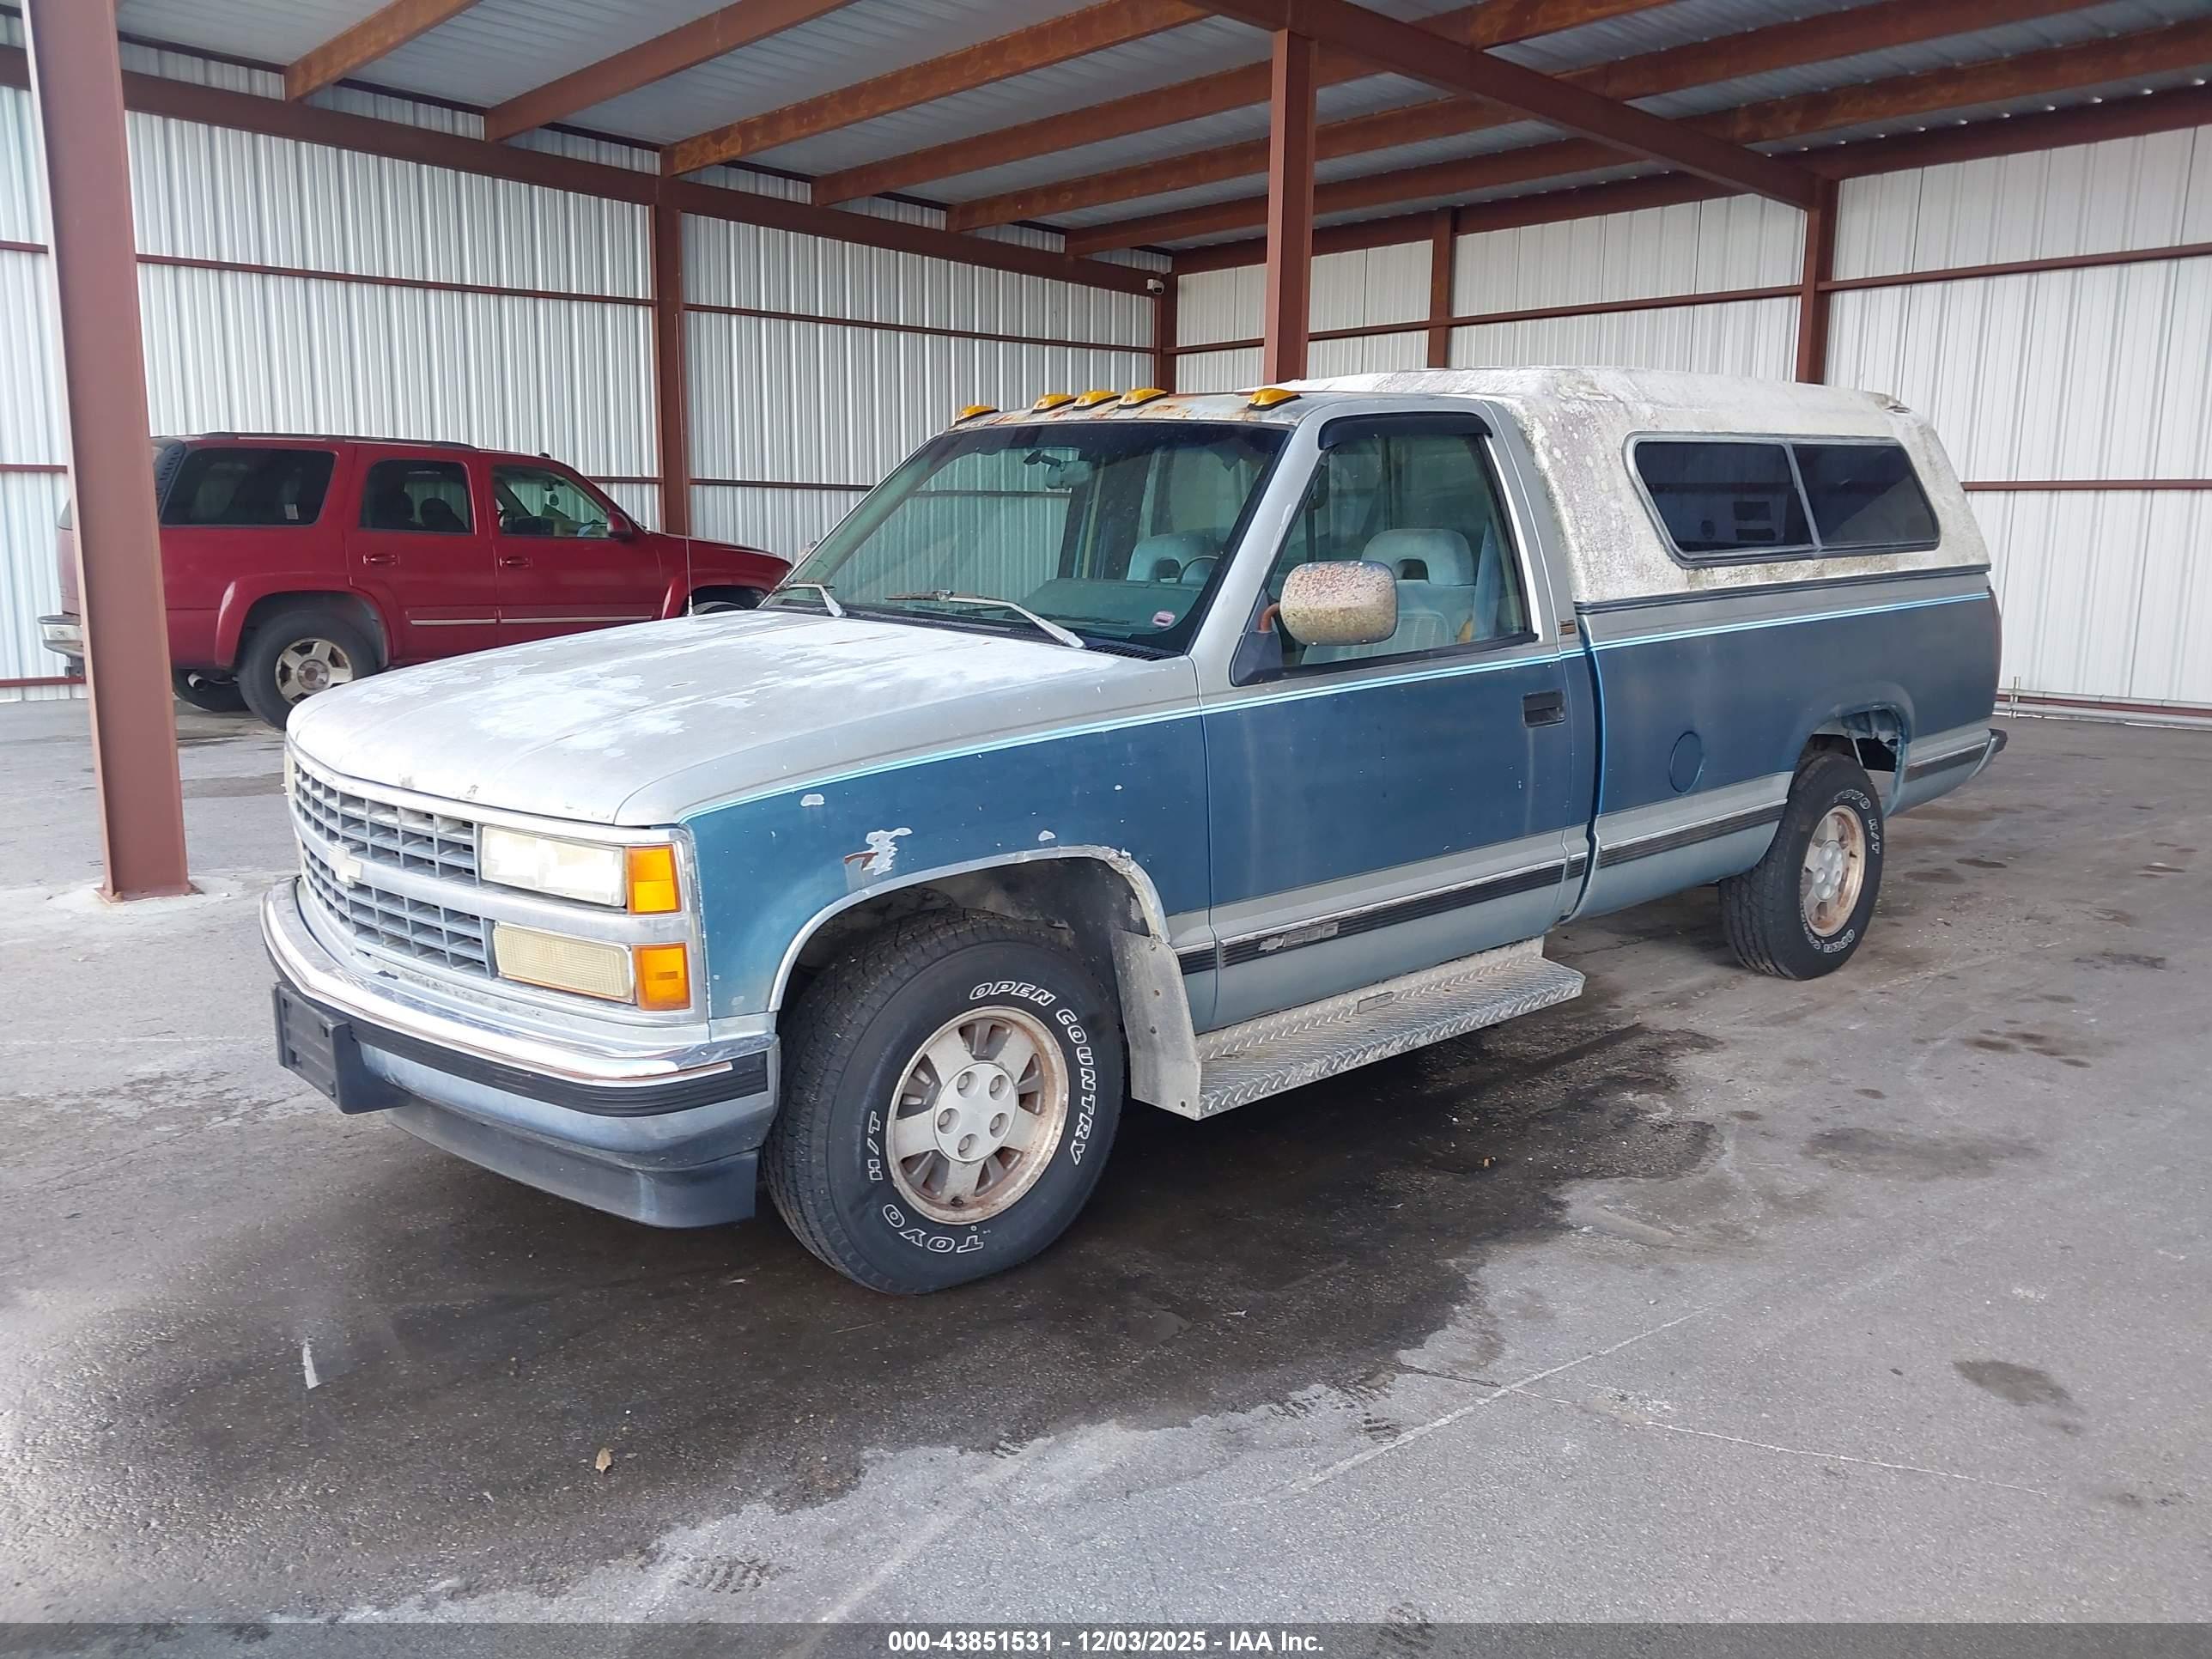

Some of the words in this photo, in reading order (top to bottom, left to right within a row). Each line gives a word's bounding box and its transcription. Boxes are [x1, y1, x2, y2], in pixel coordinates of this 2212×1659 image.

[969, 981, 1056, 1006] OPEN
[1055, 1008, 1097, 1165] COUNTRY
[866, 1110, 884, 1181] H/T
[882, 1204, 984, 1253] TOYO
